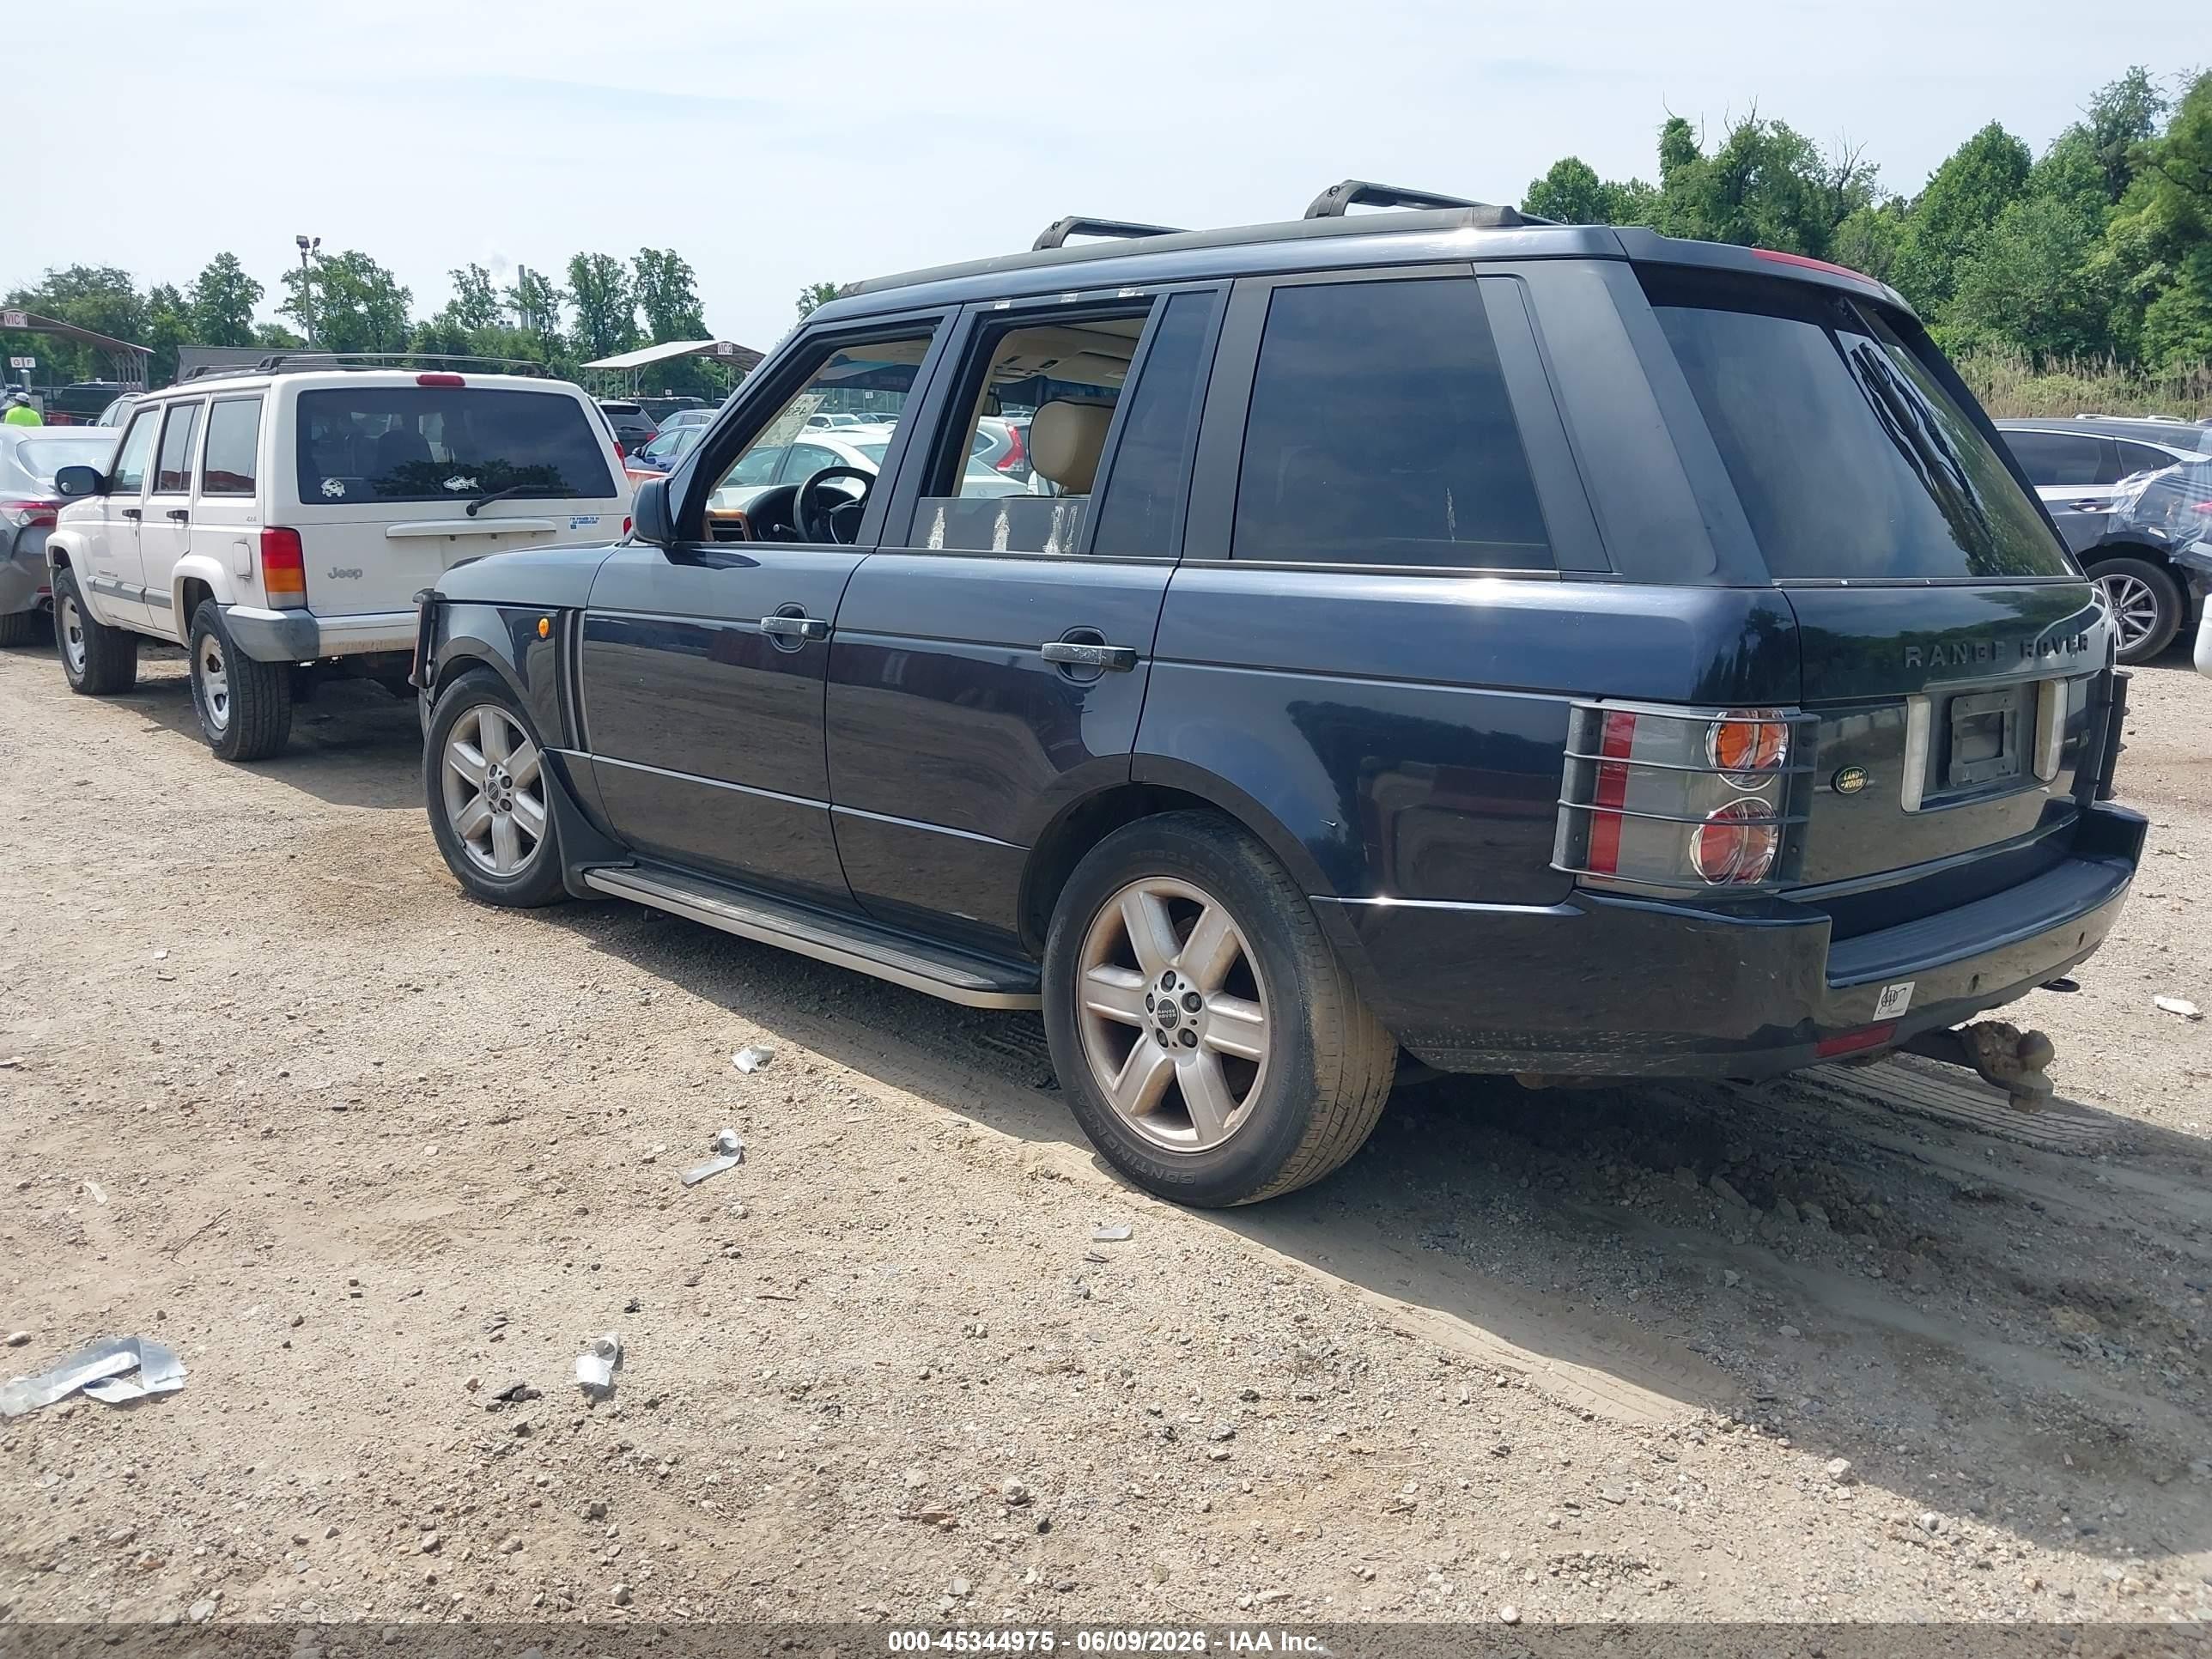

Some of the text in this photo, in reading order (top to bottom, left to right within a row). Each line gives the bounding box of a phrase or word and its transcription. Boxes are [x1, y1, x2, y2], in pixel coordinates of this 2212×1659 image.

[5, 314, 27, 325] VIC 1
[718, 344, 732, 353] VIC 2
[328, 568, 363, 580] Jeep
[1905, 634, 2089, 668] RANGE ROVER
[1844, 770, 1860, 781] LAND
[1844, 779, 1863, 789] ROVER
